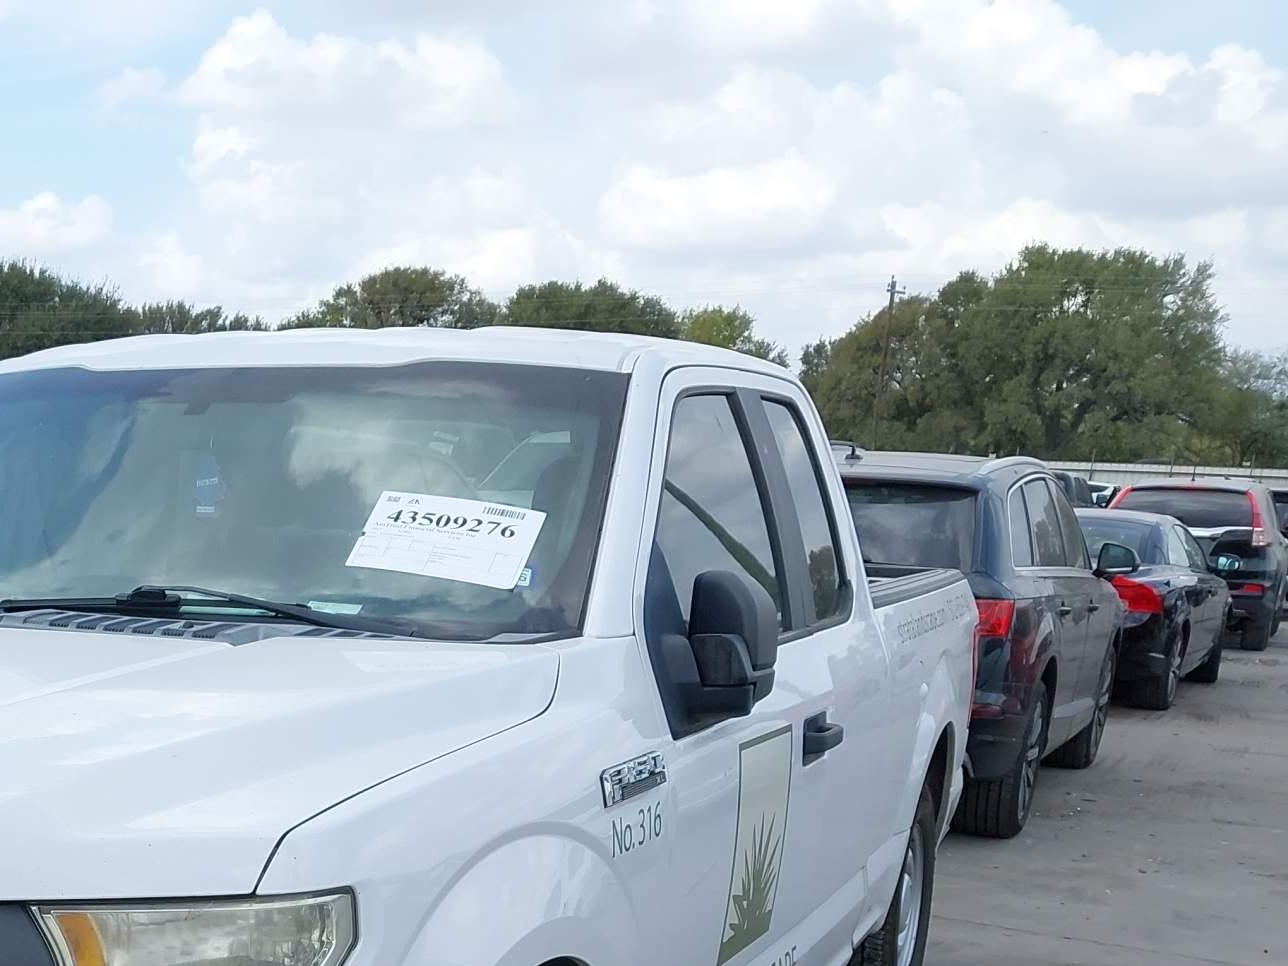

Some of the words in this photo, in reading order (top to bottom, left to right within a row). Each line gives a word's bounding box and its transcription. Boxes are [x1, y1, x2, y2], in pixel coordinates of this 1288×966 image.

[386, 509, 520, 538] 43509276
[612, 816, 635, 858] No.
[638, 800, 662, 846] 316
